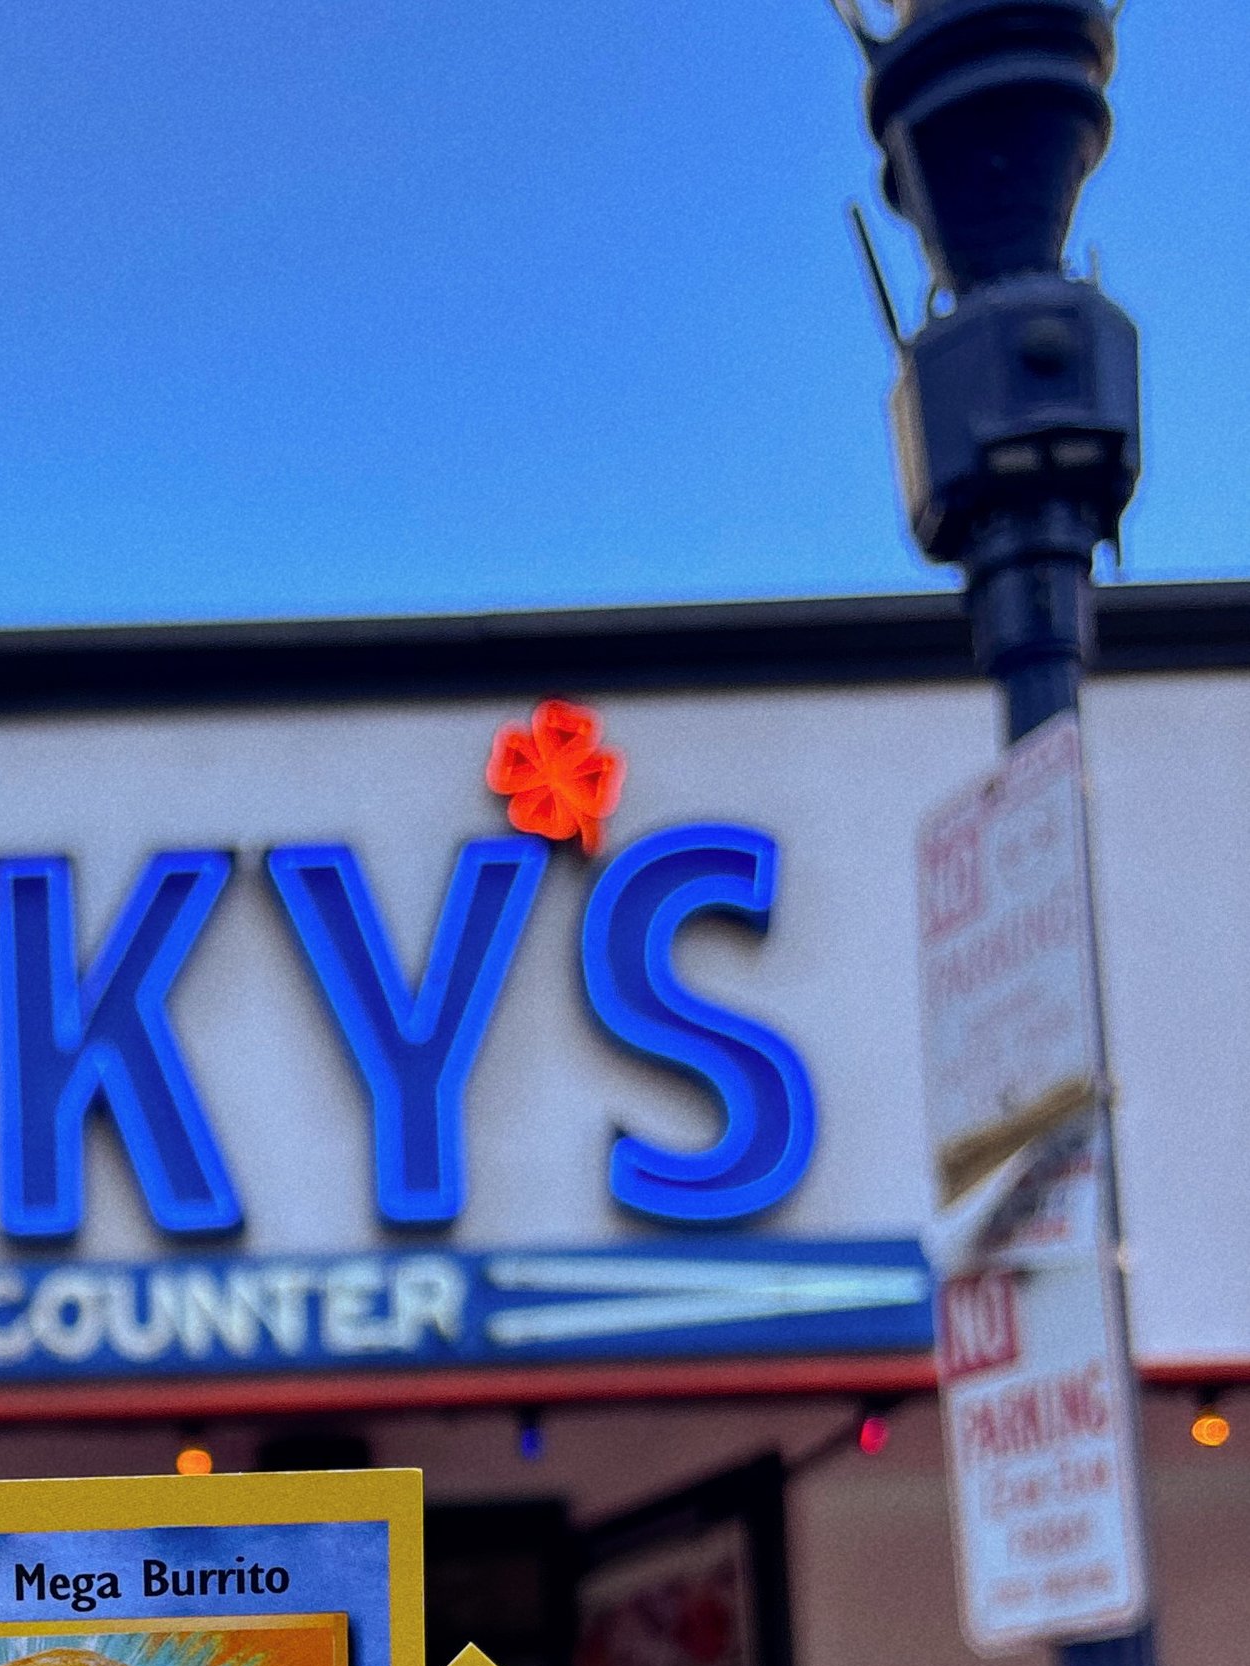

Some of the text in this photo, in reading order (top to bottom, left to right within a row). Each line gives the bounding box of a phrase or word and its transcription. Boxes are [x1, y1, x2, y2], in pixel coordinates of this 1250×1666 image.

[947, 1273, 1010, 1370] NO
[960, 1362, 1110, 1466] PARKING
[14, 1562, 123, 1613] Mega
[142, 1555, 290, 1597] Burrito
